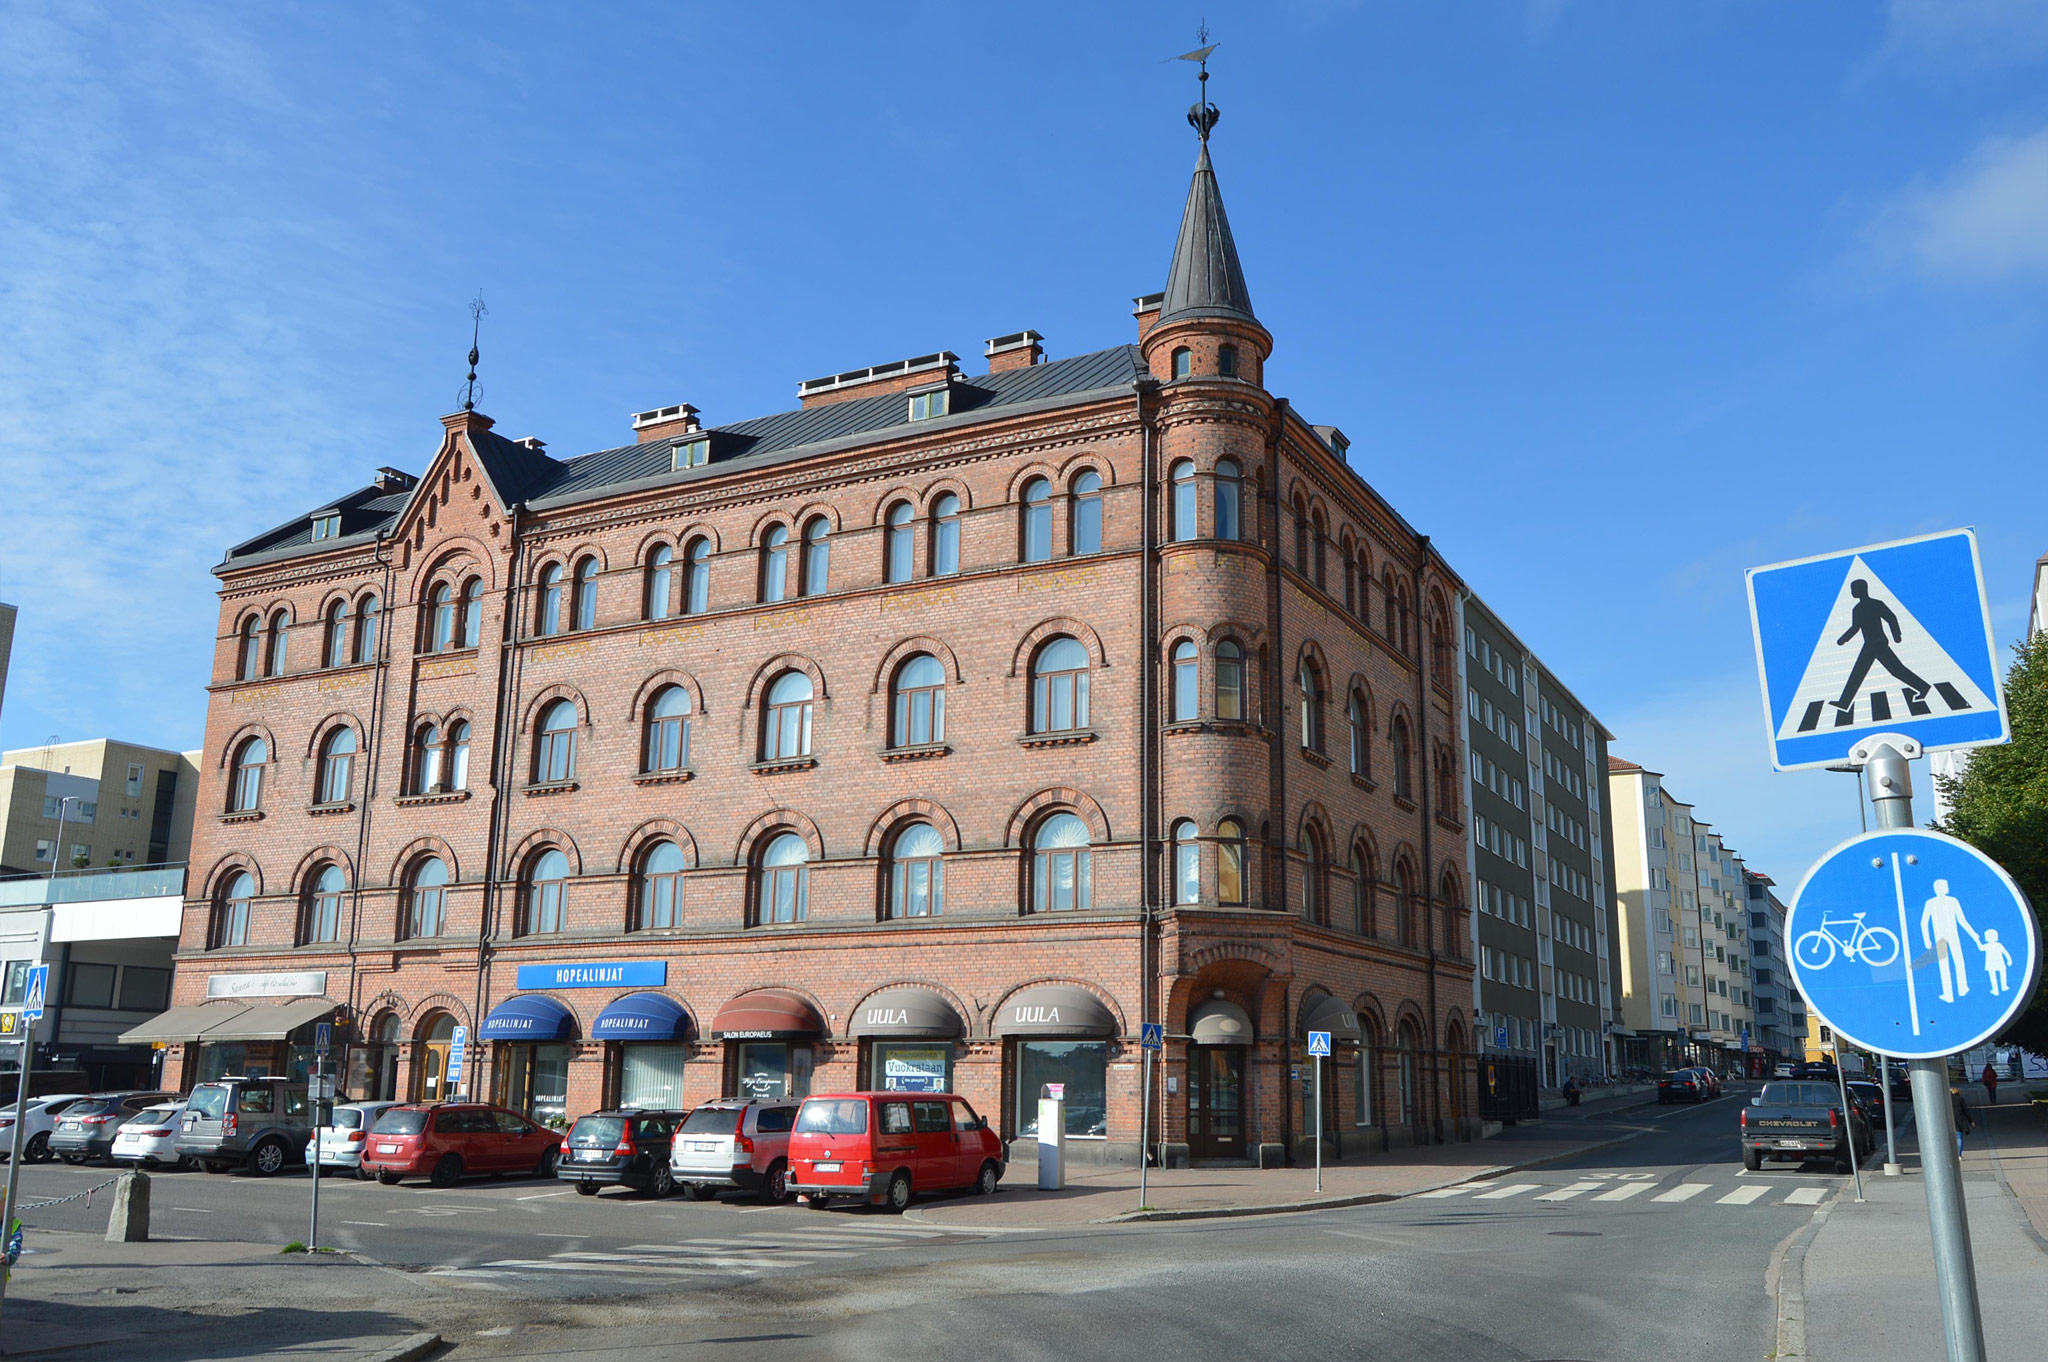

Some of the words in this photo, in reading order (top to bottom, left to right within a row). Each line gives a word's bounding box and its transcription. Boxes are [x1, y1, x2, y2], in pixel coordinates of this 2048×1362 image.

[556, 968, 623, 983] HOPEALINJAT
[867, 1009, 907, 1024] UULA
[1015, 1007, 1060, 1022] UULA
[487, 1018, 533, 1029] HOPEALINJAT
[601, 1018, 649, 1029] HOPEALINJAT
[455, 1029, 464, 1043] P
[723, 1031, 739, 1039] SALON
[888, 1062, 943, 1073] Vuokrataan
